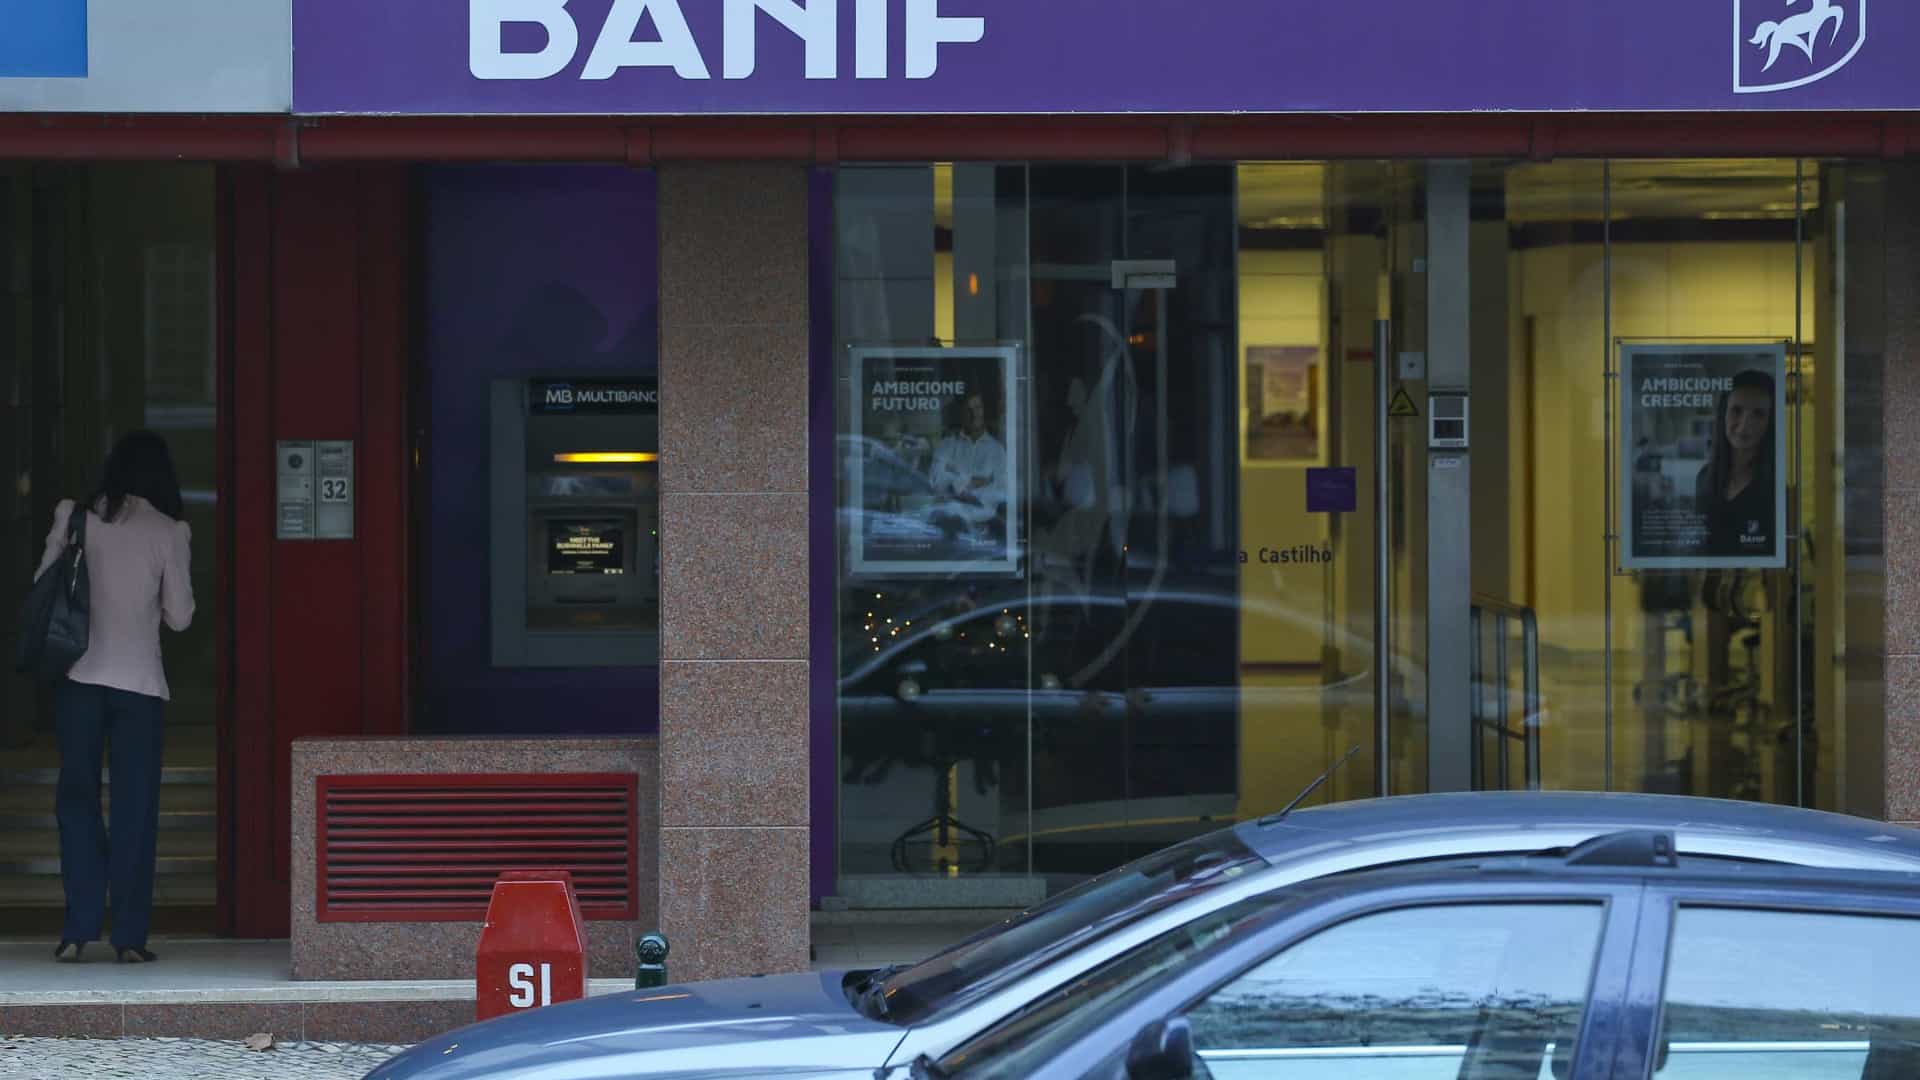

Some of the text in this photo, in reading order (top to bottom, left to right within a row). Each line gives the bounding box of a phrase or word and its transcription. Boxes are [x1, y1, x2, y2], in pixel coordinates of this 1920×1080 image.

[469, 0, 985, 80] BANIF
[871, 381, 965, 395] AMBICIONE
[1641, 377, 1733, 392] AMBICIONE
[546, 389, 573, 404] MB
[872, 397, 940, 411] FUTURO
[1641, 393, 1713, 408] CRESCER
[323, 480, 346, 499] 32
[1259, 544, 1332, 564] Castilho
[509, 963, 551, 1008] SI
